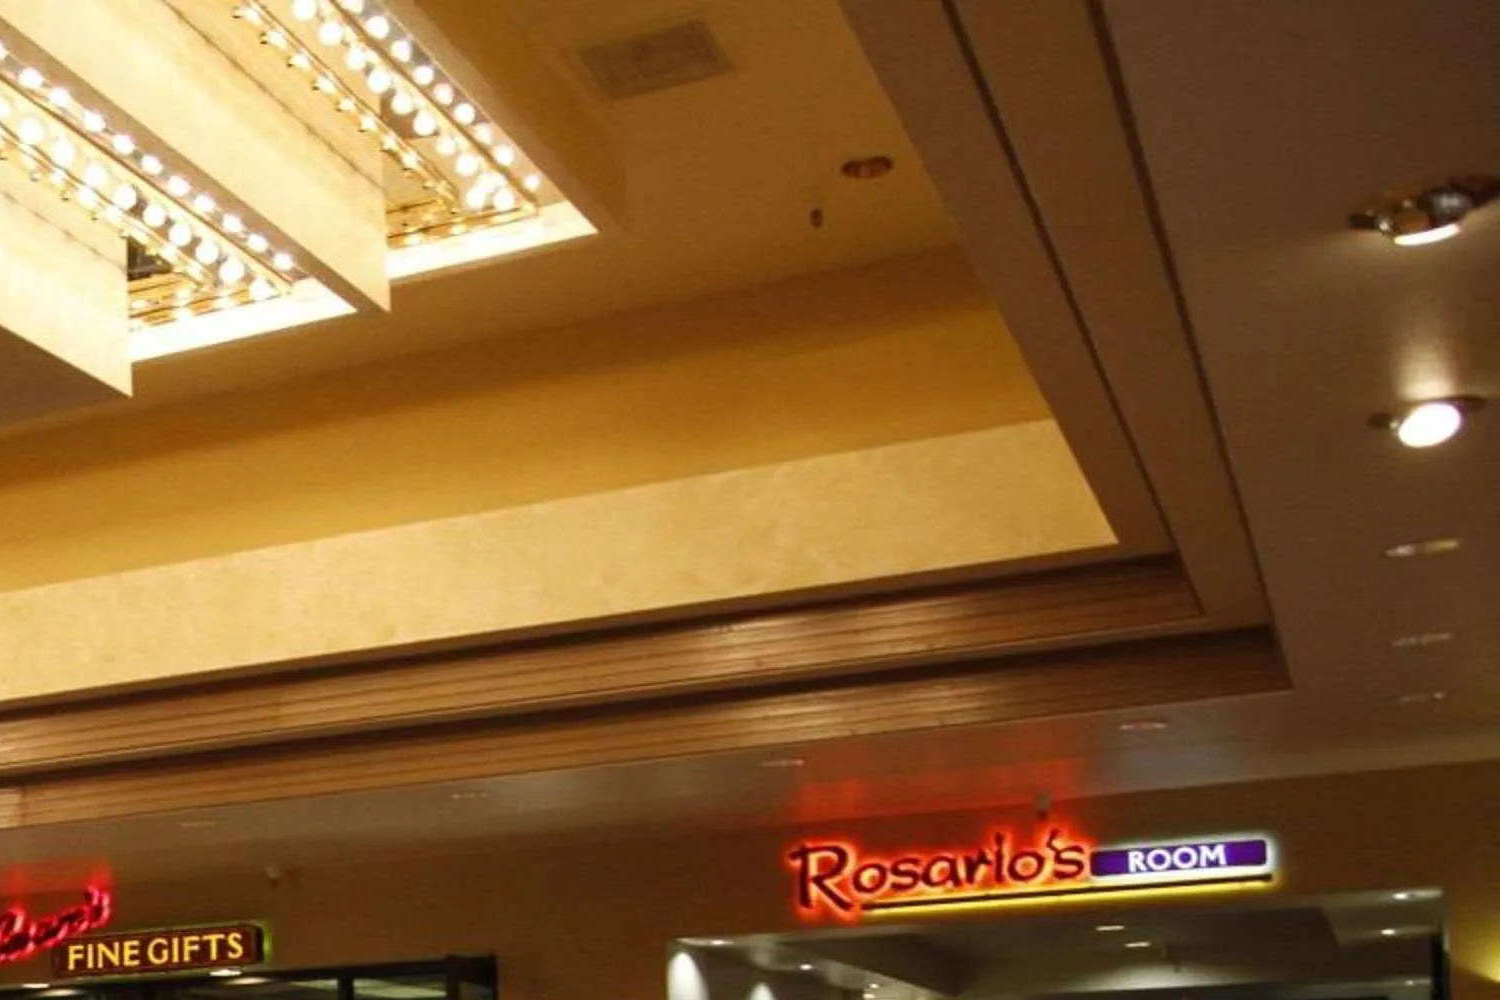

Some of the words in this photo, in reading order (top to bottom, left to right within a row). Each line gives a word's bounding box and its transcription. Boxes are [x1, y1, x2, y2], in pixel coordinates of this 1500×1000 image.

[789, 829, 1085, 911] Rosario's
[1127, 844, 1227, 874] ROOM
[67, 939, 141, 971] FINE
[146, 931, 244, 965] GIFTS
